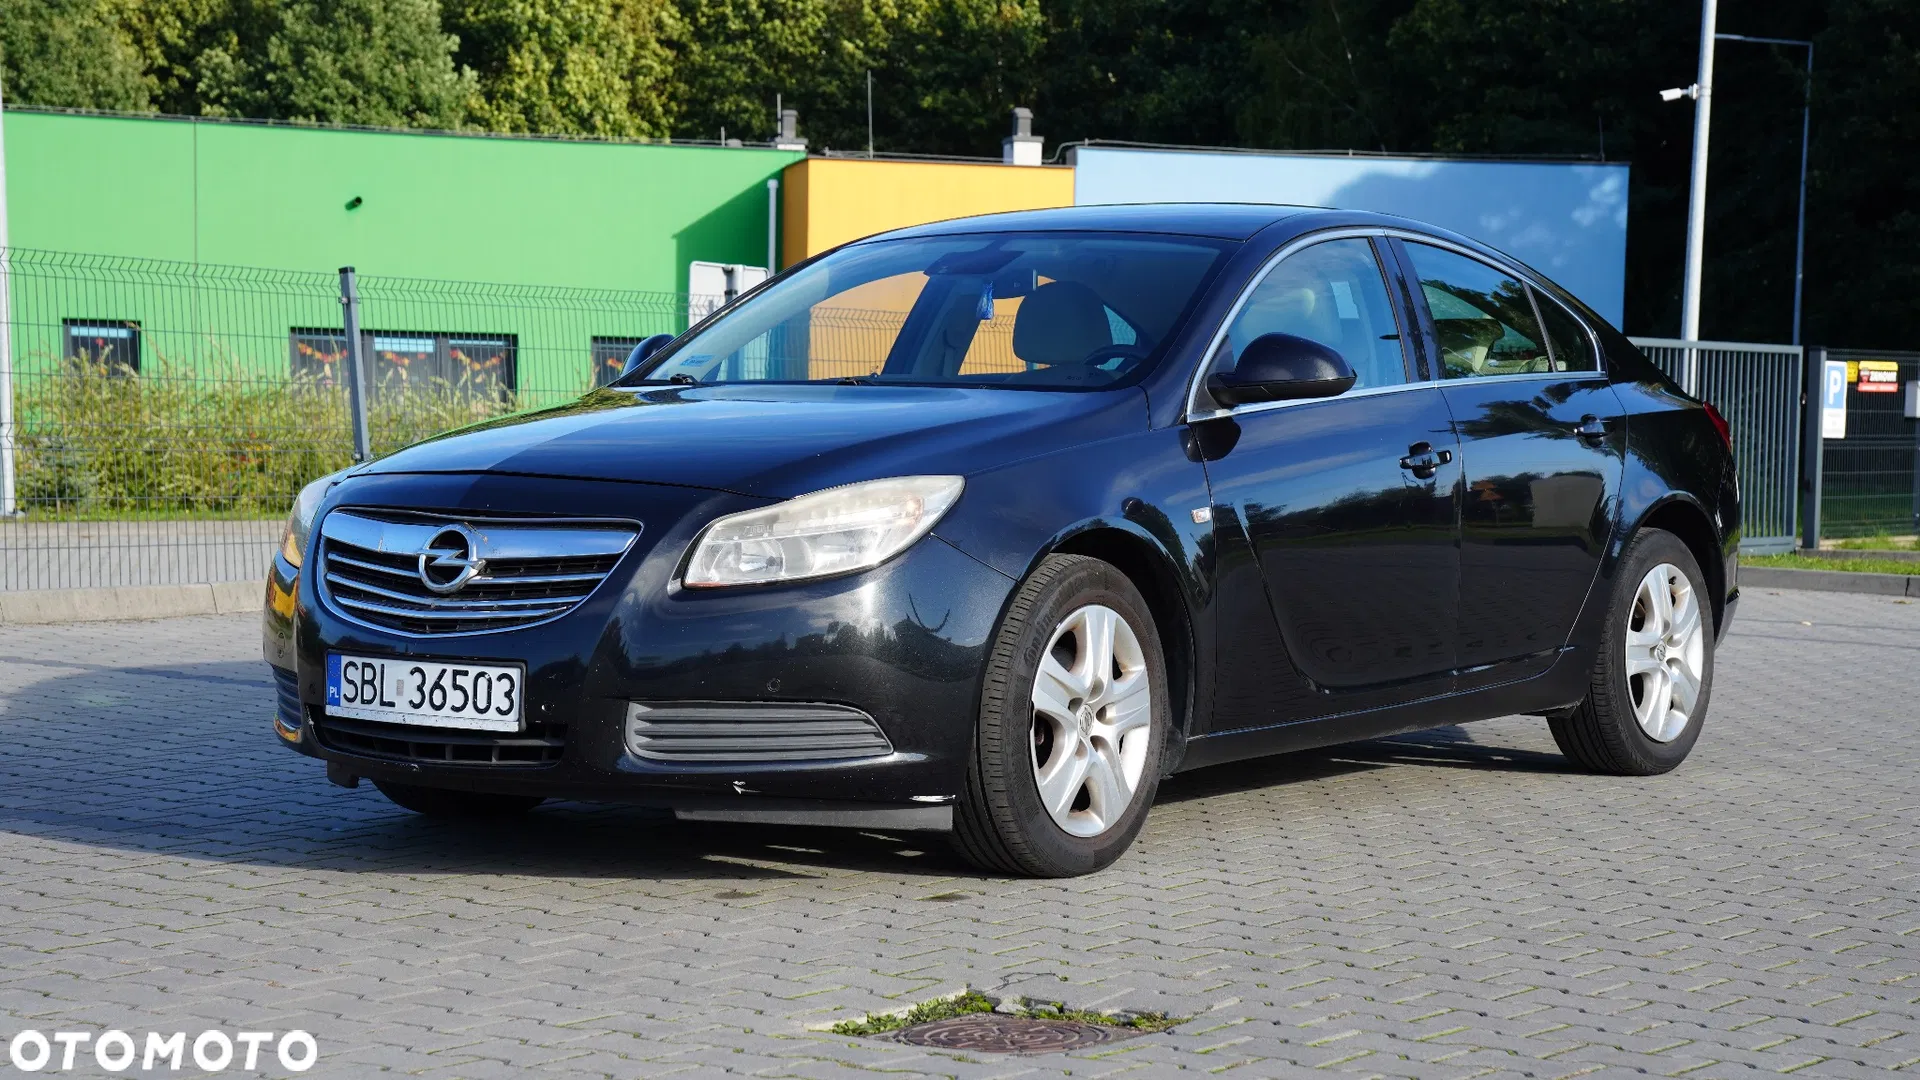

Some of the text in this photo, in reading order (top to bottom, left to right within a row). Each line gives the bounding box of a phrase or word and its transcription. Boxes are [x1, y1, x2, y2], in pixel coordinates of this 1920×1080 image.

[1828, 370, 1842, 406] P
[329, 685, 340, 699] PL
[343, 660, 516, 716] SBL 36503
